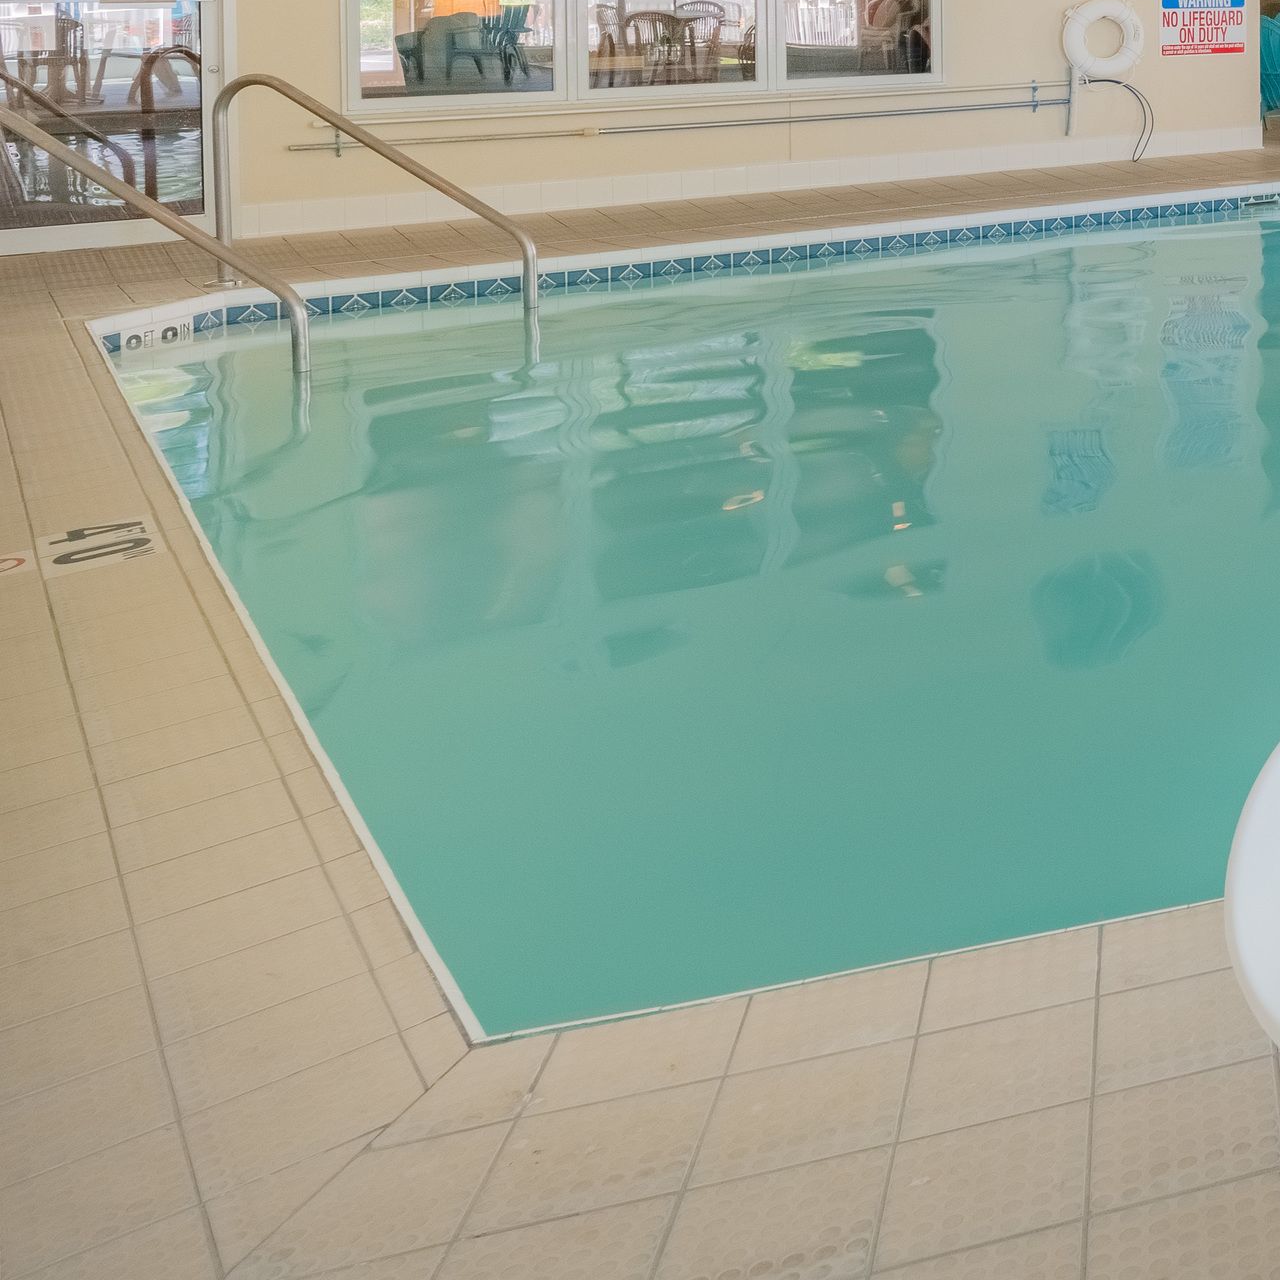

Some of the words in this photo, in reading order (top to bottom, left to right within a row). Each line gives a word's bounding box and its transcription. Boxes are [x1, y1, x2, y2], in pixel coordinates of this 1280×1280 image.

[1162, 11, 1178, 27] NO
[1182, 10, 1243, 27] LIFEGUARD
[1179, 28, 1194, 43] ON
[1199, 27, 1227, 42] DUTY
